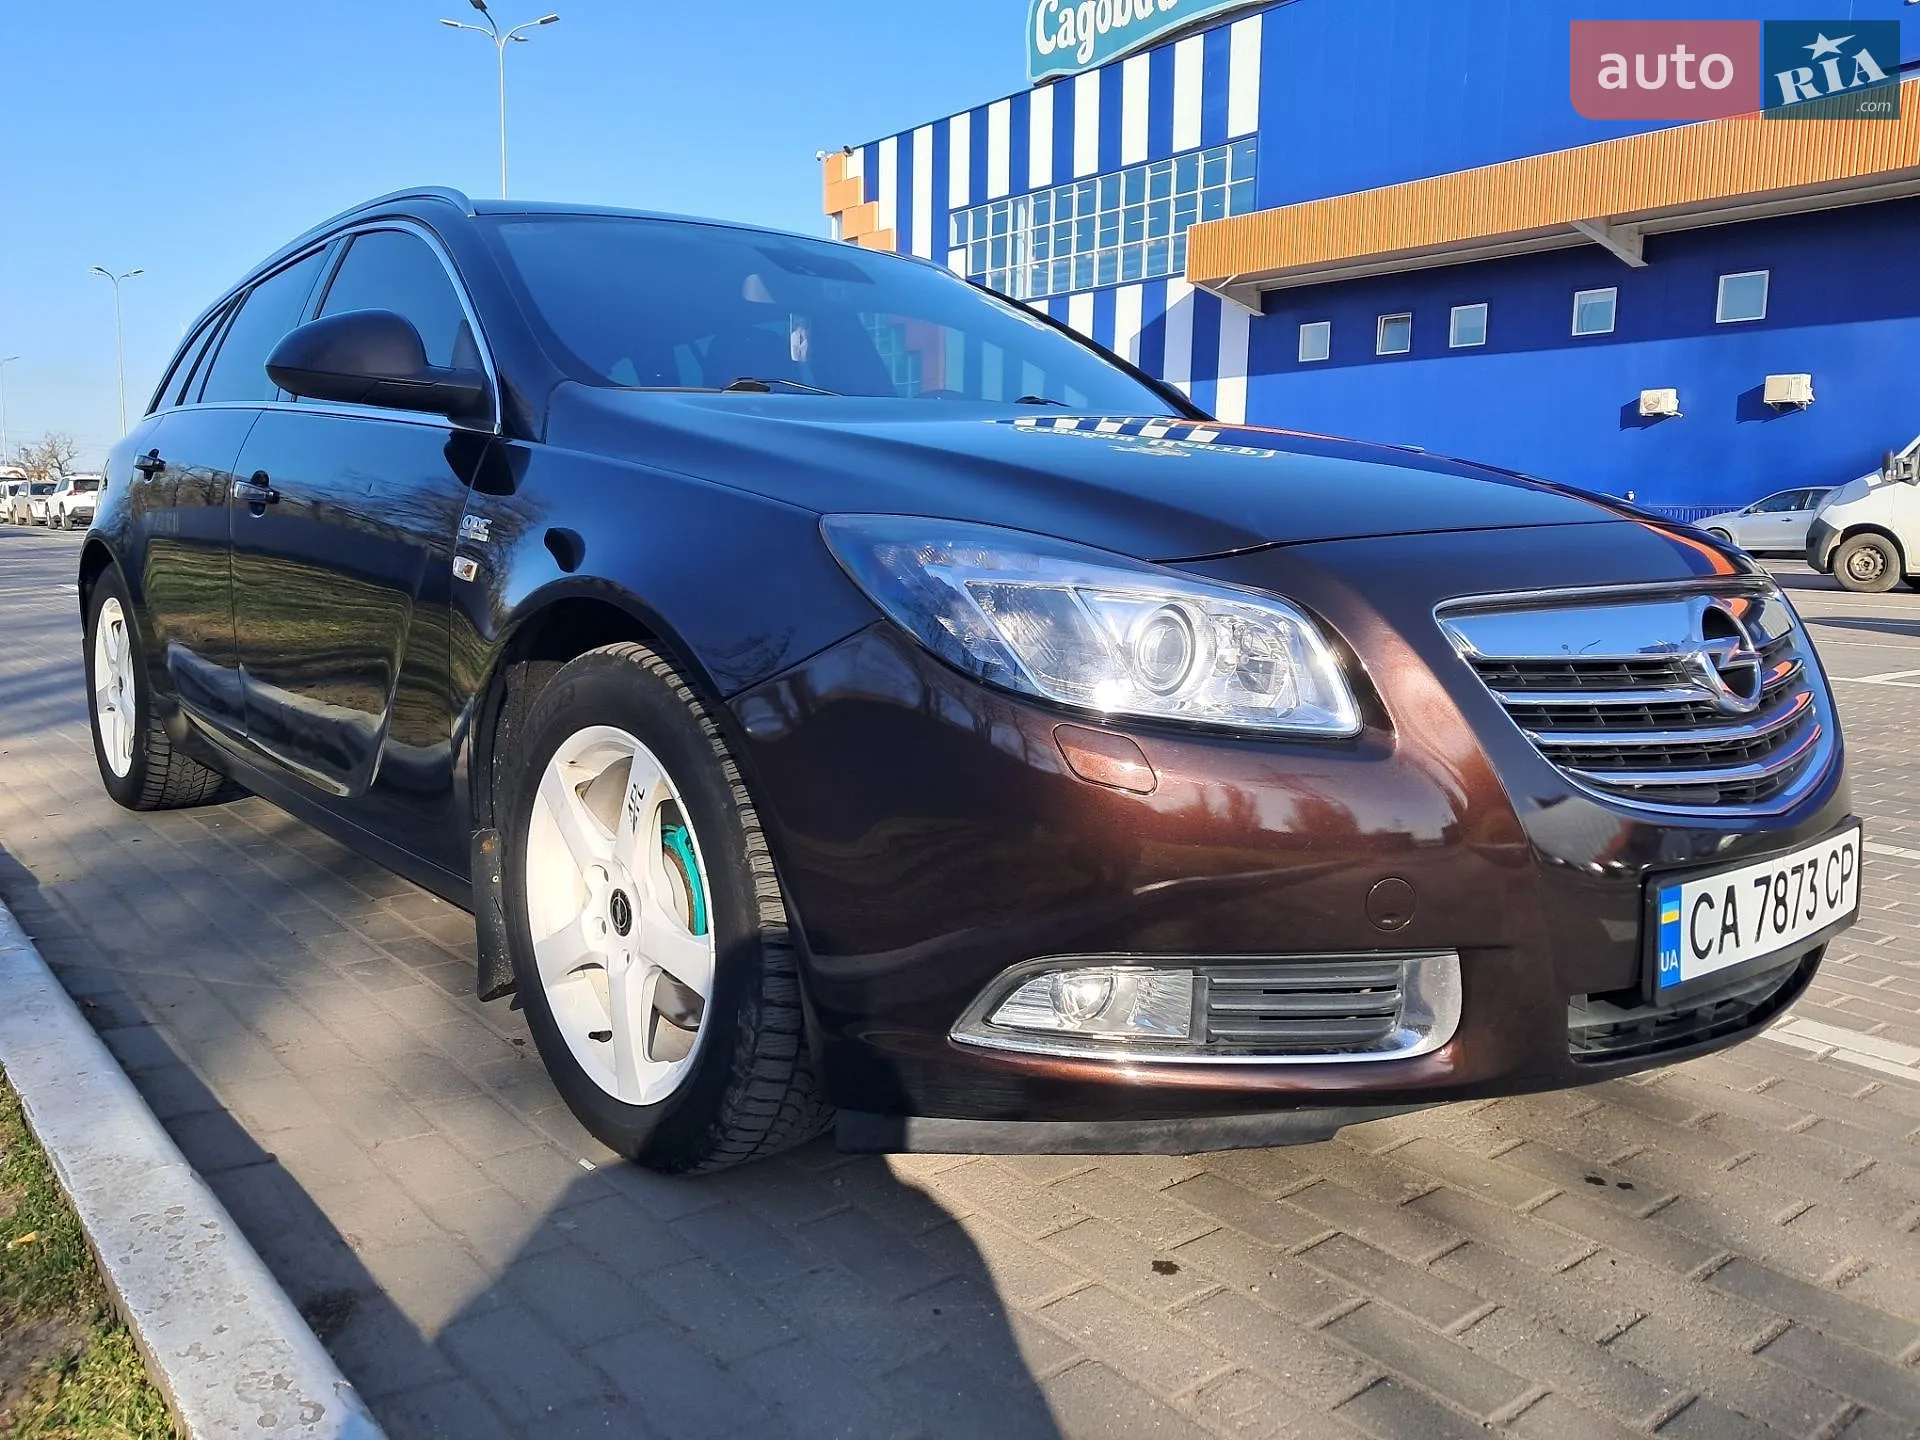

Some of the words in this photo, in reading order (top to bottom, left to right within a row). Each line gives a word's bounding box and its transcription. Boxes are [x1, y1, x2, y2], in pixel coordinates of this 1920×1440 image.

[1689, 884, 1741, 960] CA
[1754, 857, 1818, 943] 7873
[1825, 842, 1854, 910] CP
[1660, 950, 1679, 972] UA
